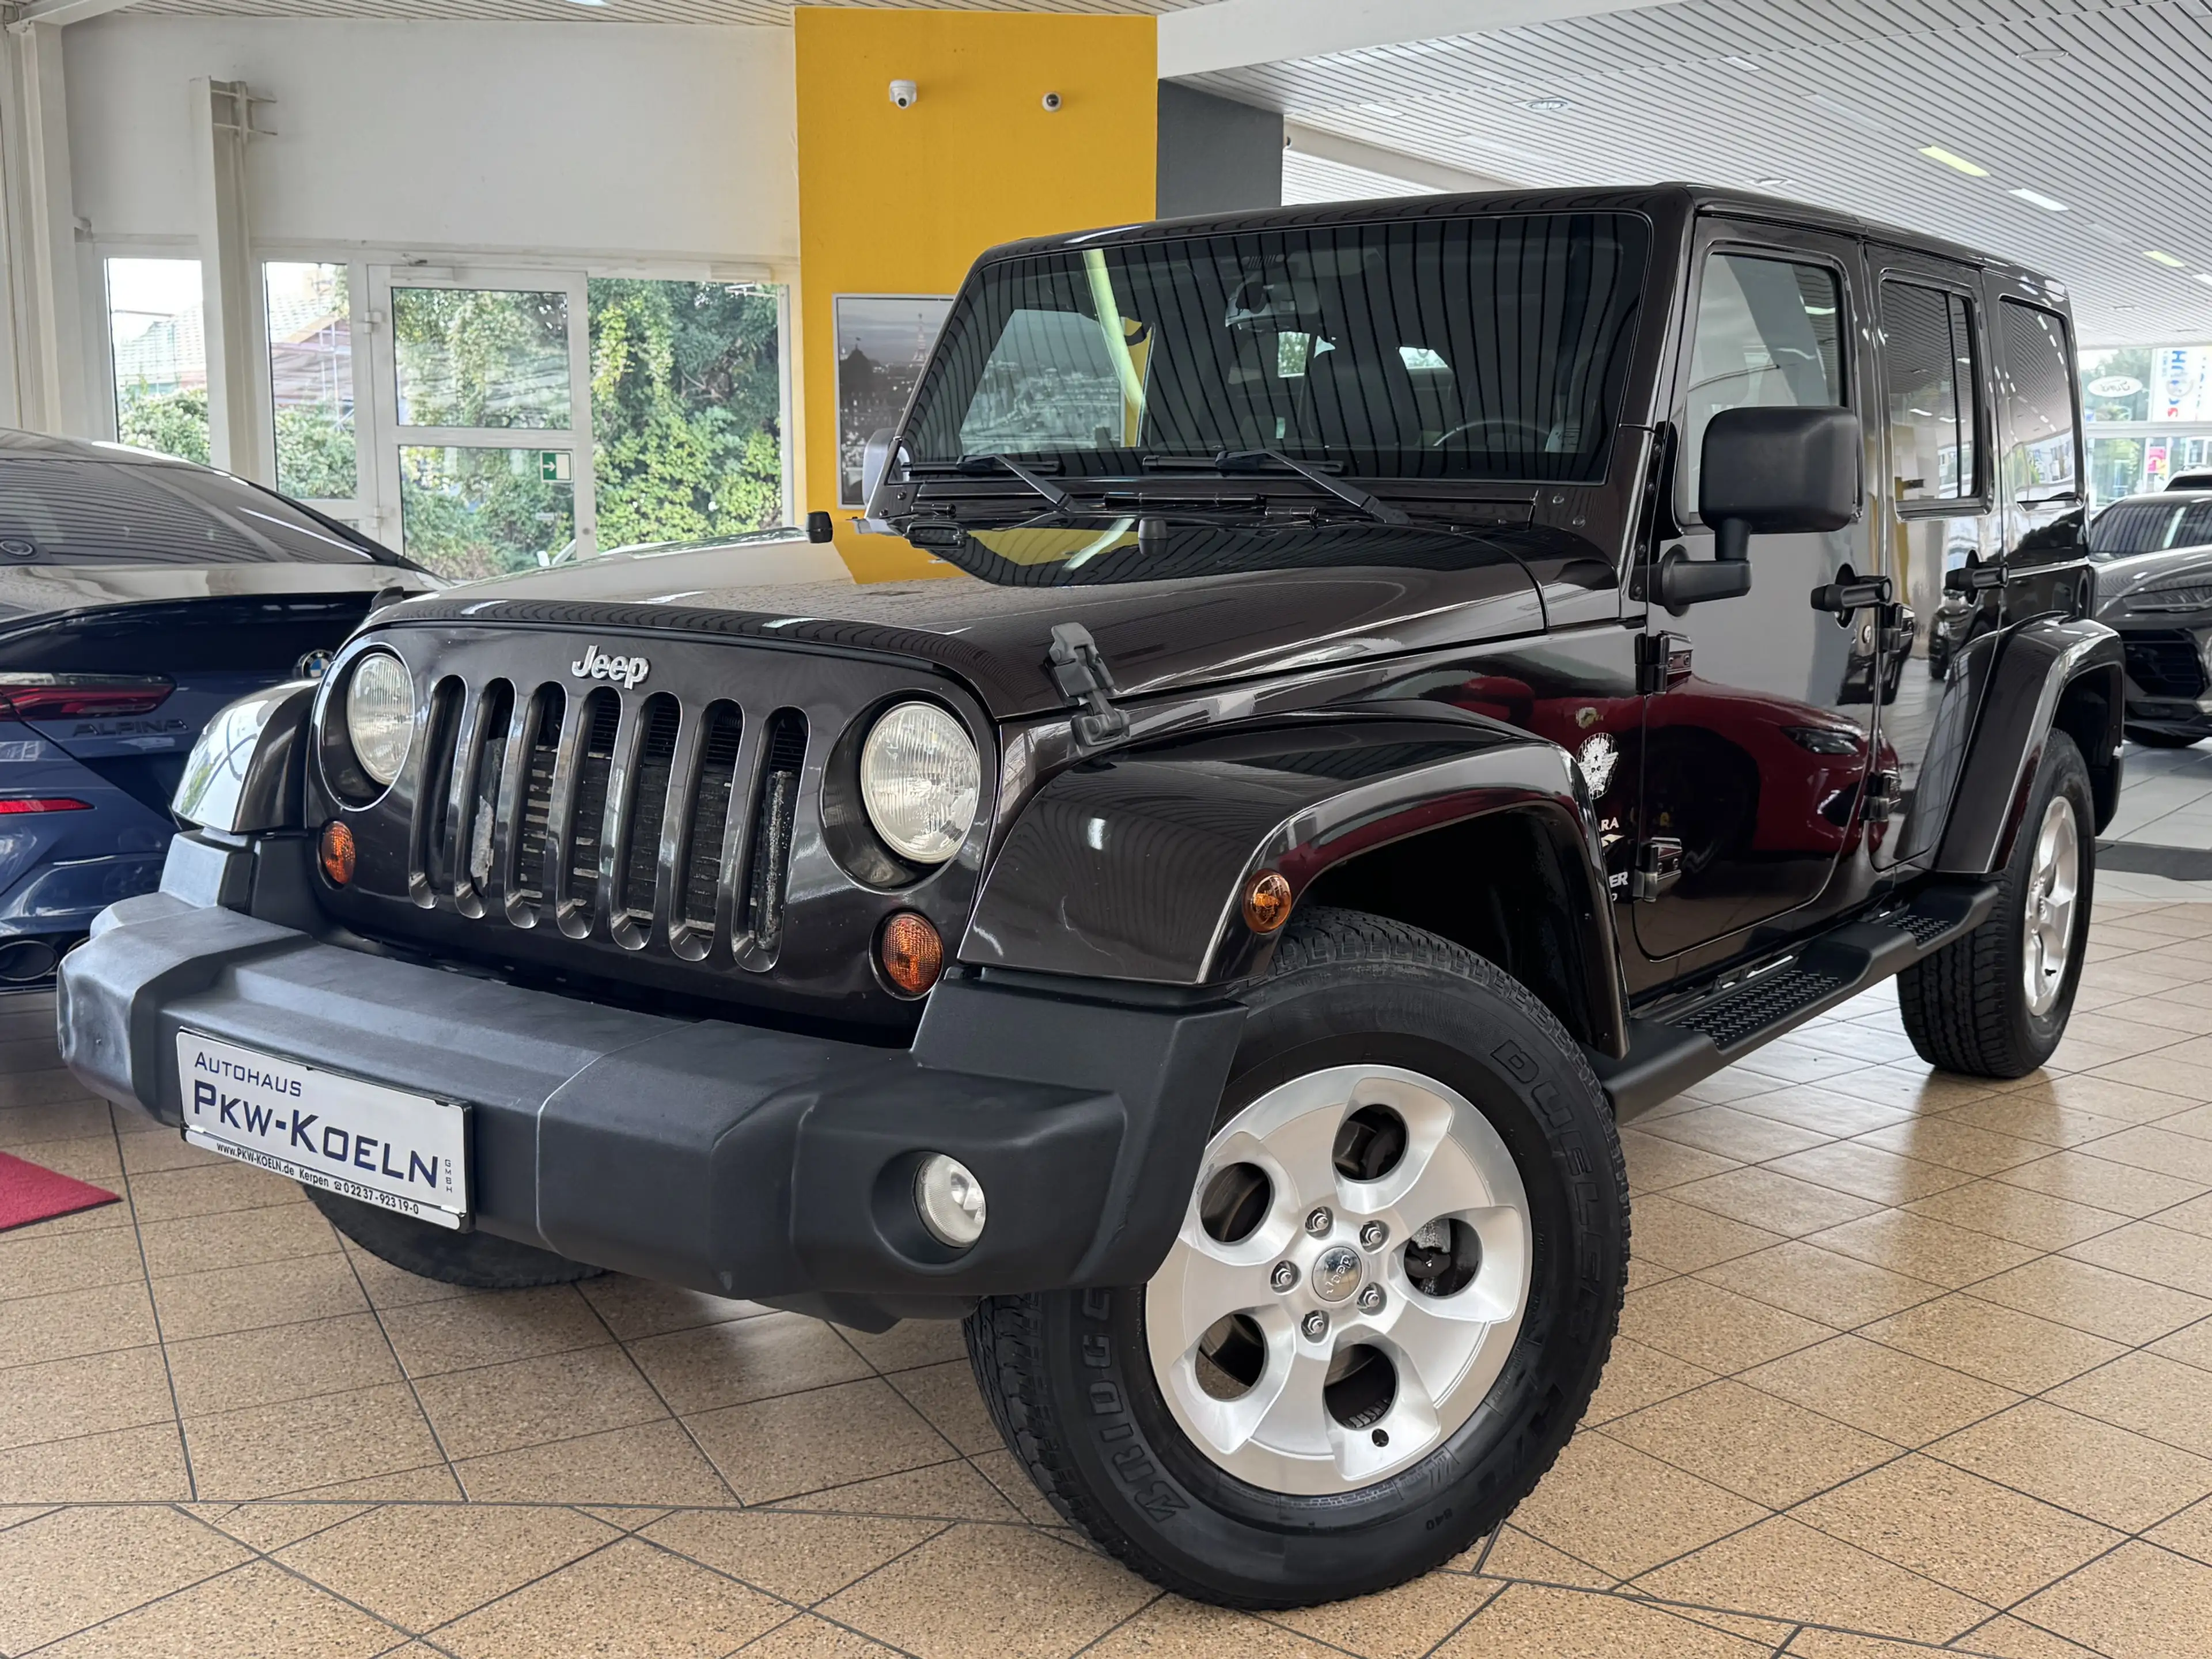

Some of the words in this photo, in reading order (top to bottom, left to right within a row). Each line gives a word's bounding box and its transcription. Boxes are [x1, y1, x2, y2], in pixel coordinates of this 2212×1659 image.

[571, 645, 649, 690] Jeep
[73, 718, 189, 737] ALPINA
[1599, 816, 1620, 832] RA
[1608, 871, 1629, 888] ER
[194, 1051, 302, 1097] AUTOHAUS
[194, 1078, 439, 1189] PKW-KOELN
[216, 1142, 294, 1176] www.PKW-KOELN.de
[298, 1166, 329, 1188] Kerpen
[1081, 1287, 1190, 1523] BRIDGE
